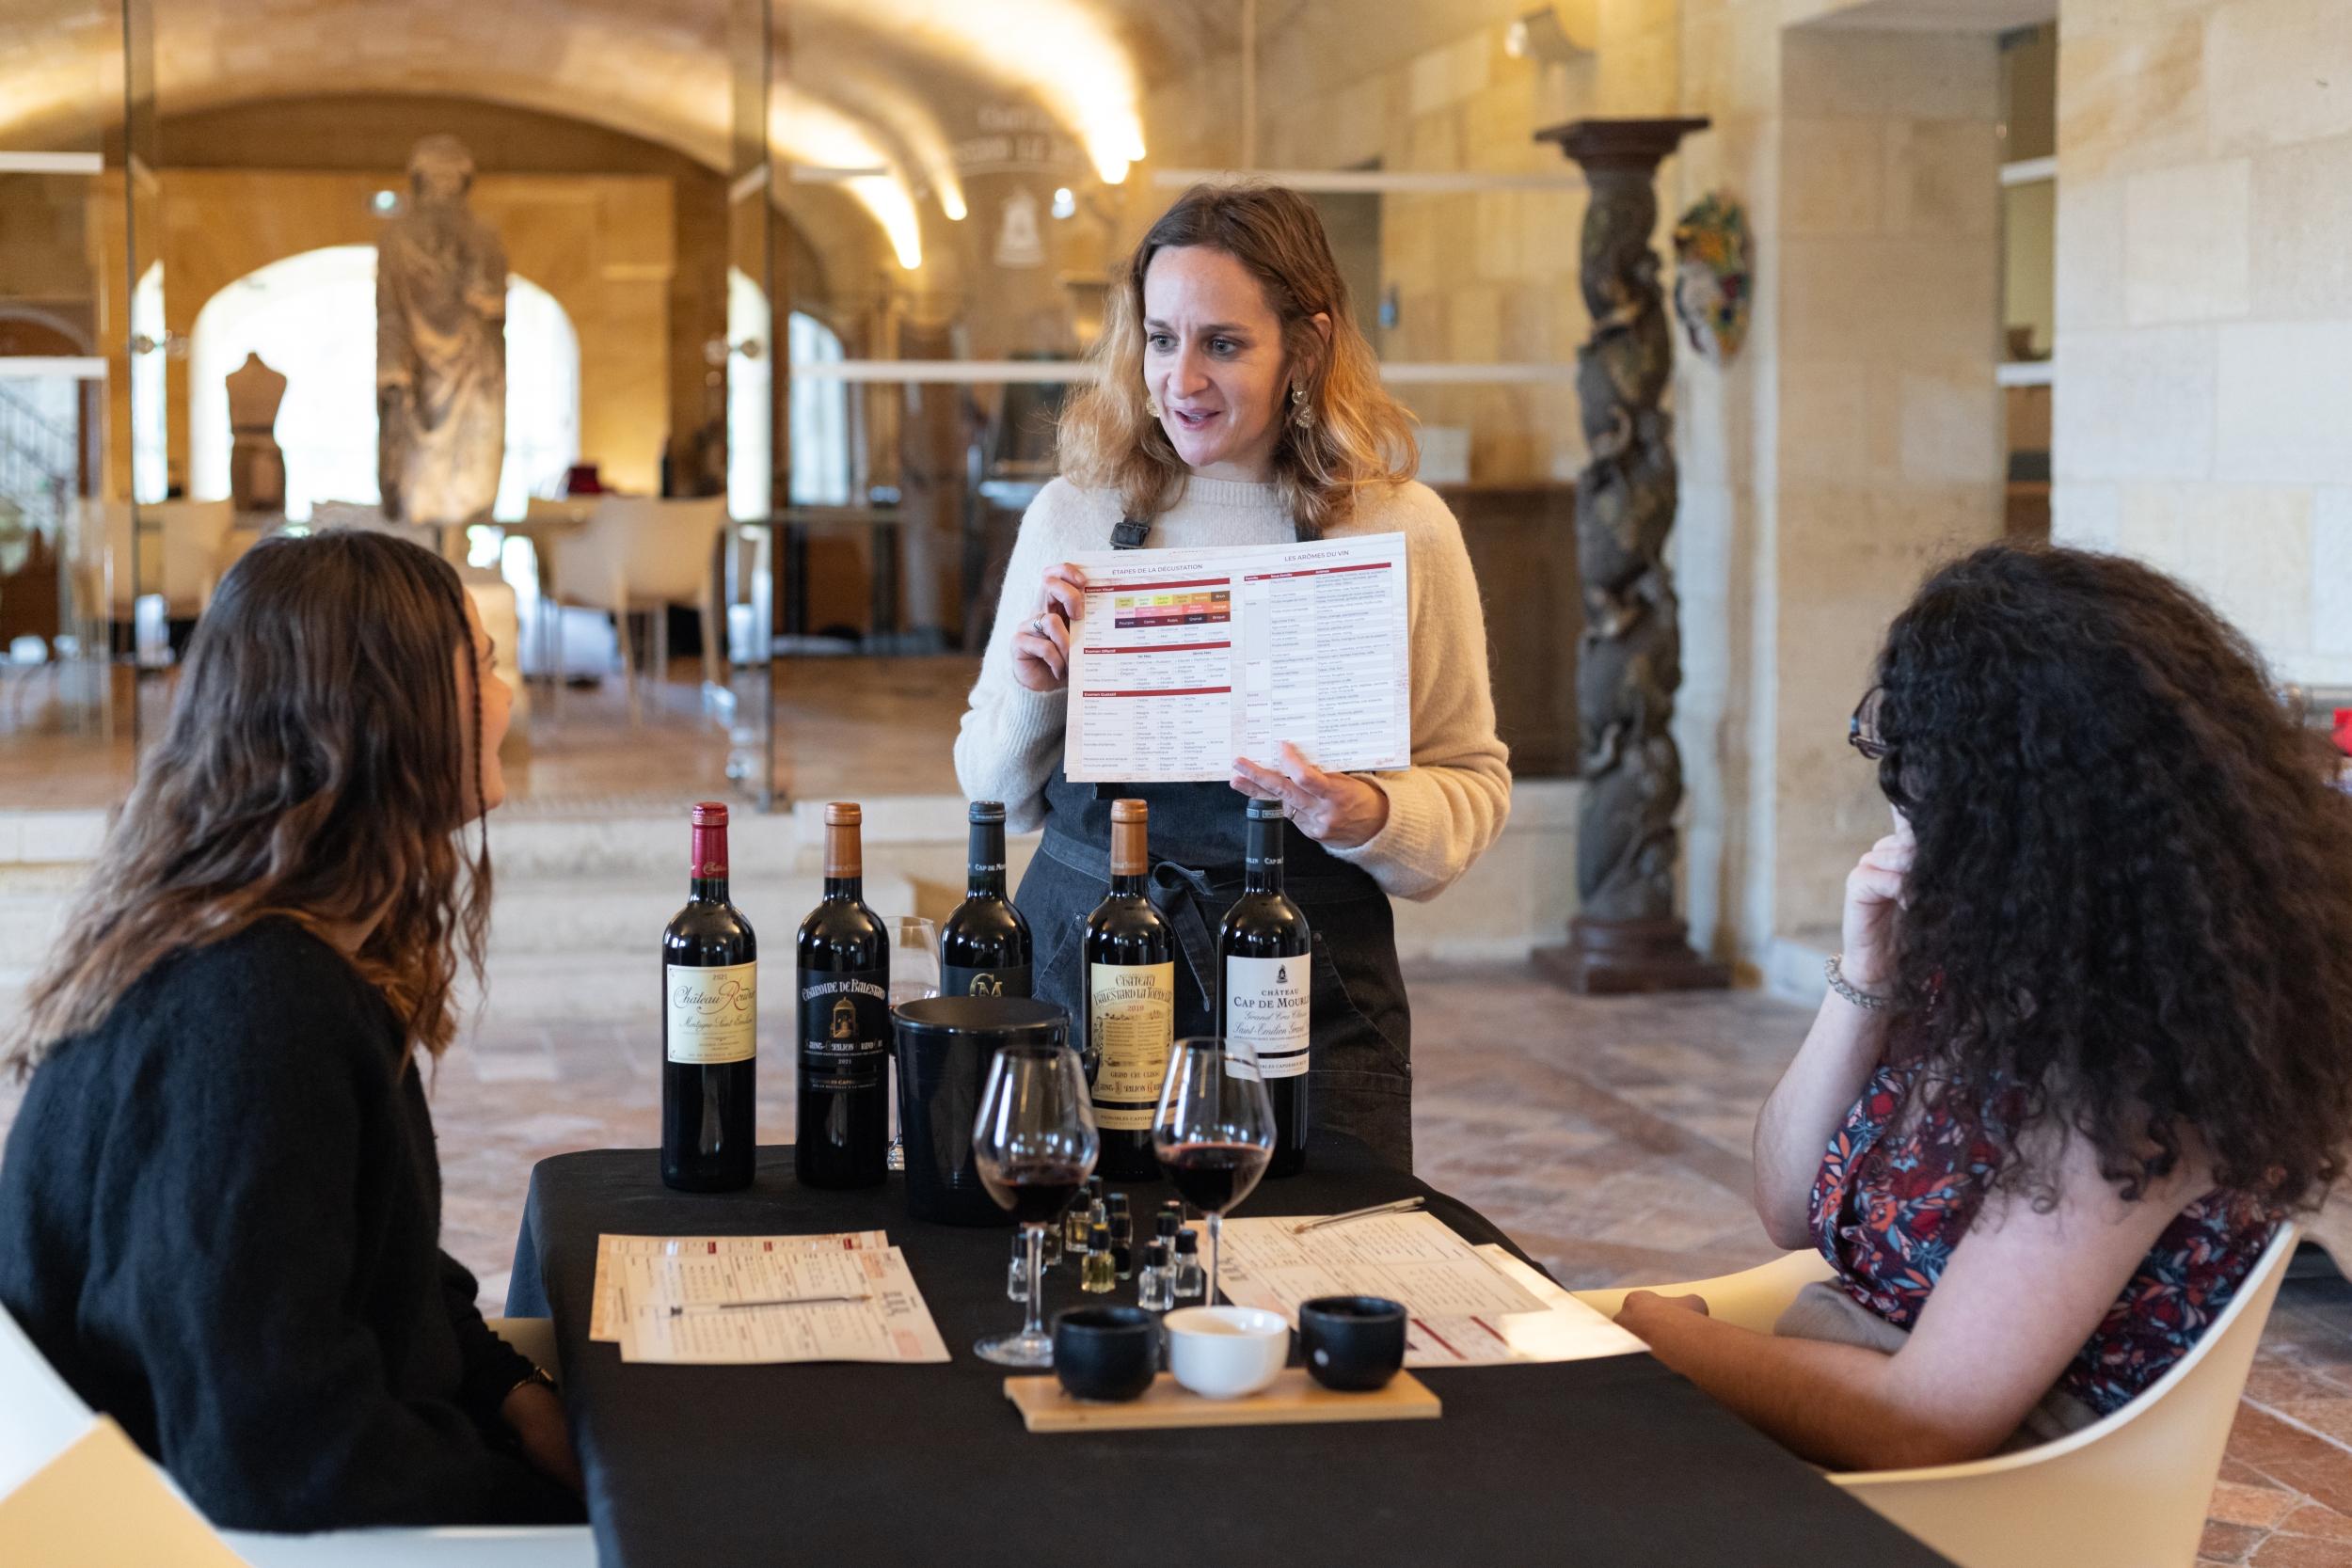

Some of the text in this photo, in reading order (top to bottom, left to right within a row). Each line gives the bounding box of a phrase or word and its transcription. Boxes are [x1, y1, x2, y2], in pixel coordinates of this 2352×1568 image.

[1297, 552, 1326, 561] ARÔMES
[1261, 988, 1299, 996] CHÂTEAU
[673, 986, 721, 1009] Château
[1258, 1000, 1274, 1008] DE
